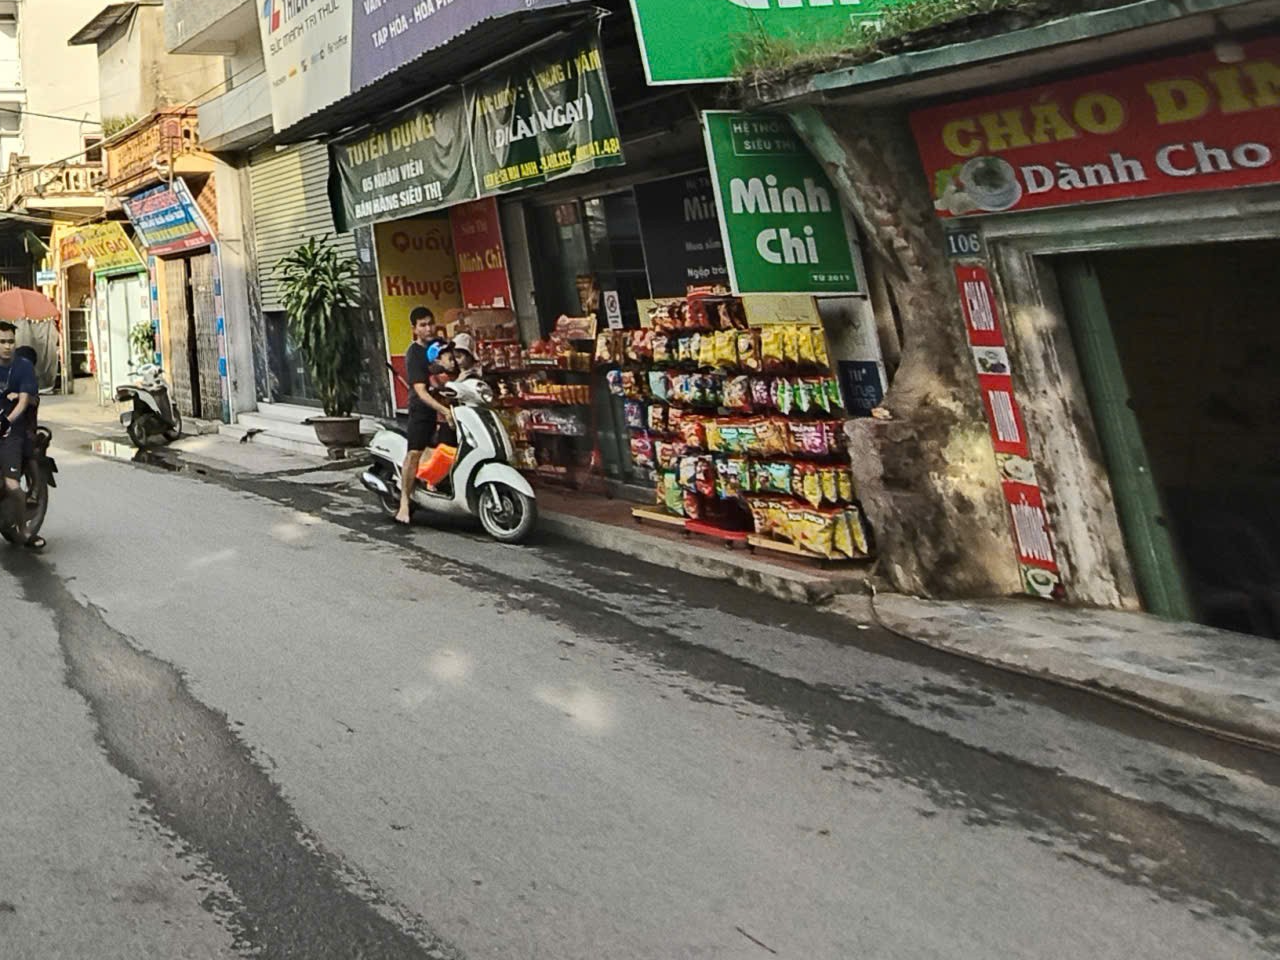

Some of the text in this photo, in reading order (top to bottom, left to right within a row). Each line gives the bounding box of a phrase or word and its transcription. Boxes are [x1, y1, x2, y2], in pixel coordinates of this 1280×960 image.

[538, 92, 594, 131] NGAY)
[942, 92, 1125, 157] CHÁO
[391, 113, 435, 153] DỤNG
[1022, 140, 1272, 194] Dành Cho
[400, 185, 423, 206] SIÊU
[423, 181, 443, 201] THỊ
[730, 174, 831, 214] Minh
[485, 244, 503, 270] Chi
[756, 225, 819, 265] Chi
[948, 232, 981, 254] 106
[384, 273, 457, 301] Khuyế
